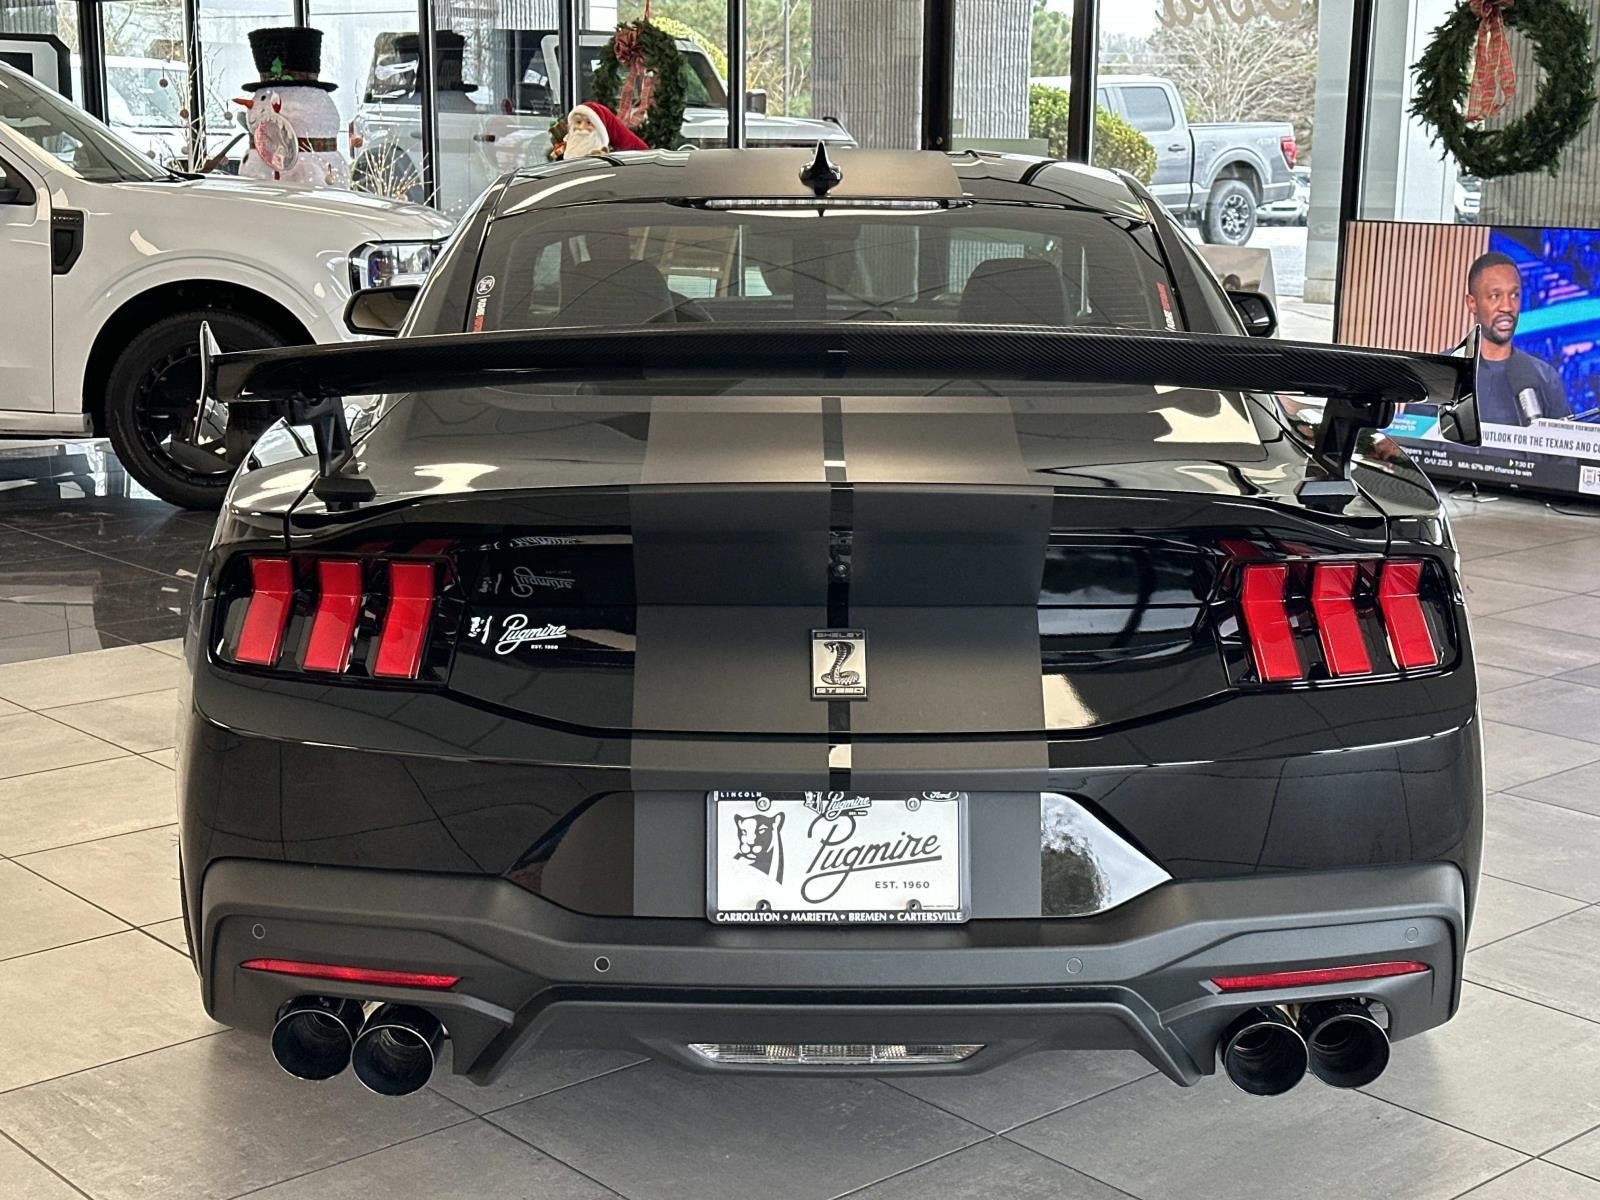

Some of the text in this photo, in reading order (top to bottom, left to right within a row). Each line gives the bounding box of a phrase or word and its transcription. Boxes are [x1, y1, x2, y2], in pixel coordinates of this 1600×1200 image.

[1513, 434, 1527, 445] FOR
[1530, 436, 1545, 447] THE
[1545, 437, 1573, 450] TEXANS
[1575, 440, 1591, 452] AND
[495, 614, 567, 655] Pugmire
[823, 791, 871, 816] Pugmire
[801, 814, 942, 905] Pugmire
[875, 880, 930, 889] EST. 1960
[717, 912, 962, 922] CARROLLTON MARIETTA BREMEN CARTERSVILLE
